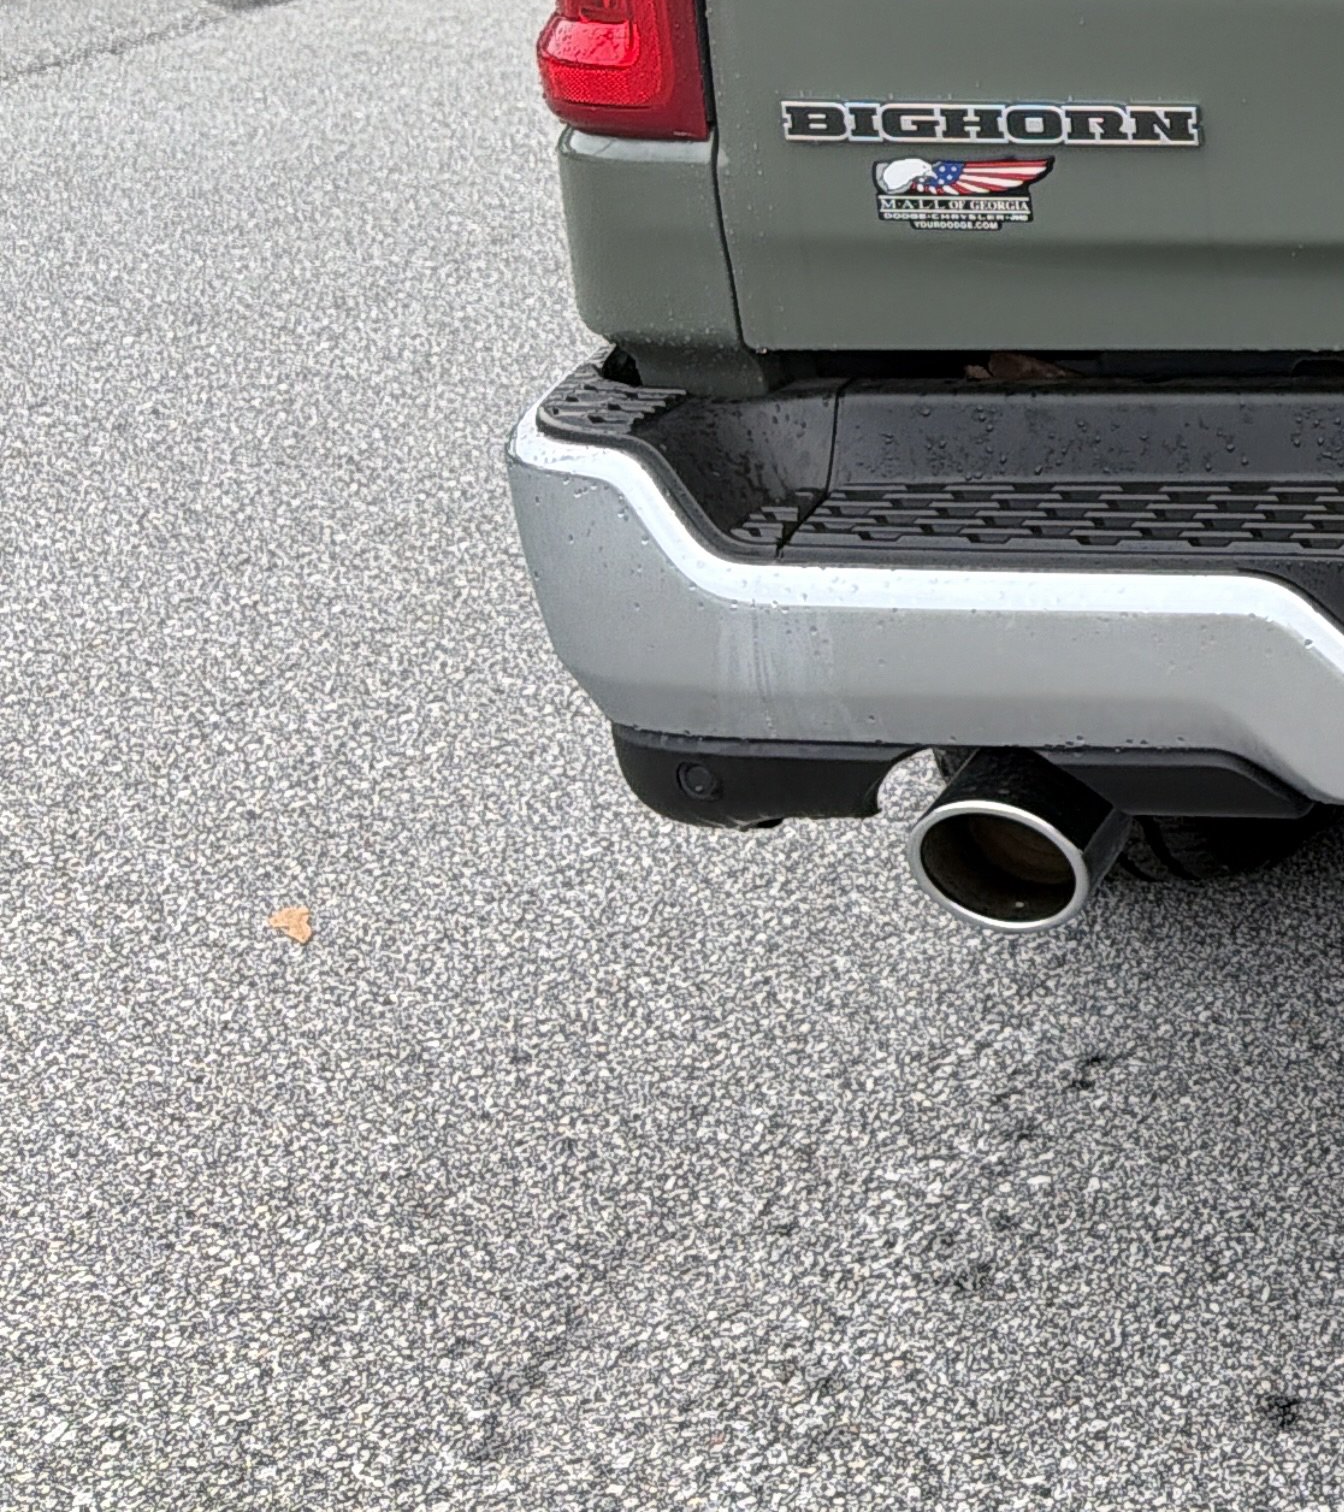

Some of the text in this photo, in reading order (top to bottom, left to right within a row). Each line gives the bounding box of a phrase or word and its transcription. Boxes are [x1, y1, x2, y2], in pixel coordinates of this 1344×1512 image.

[781, 100, 1201, 146] BIGHORN
[948, 200, 966, 210] OF
[970, 199, 1029, 211] GEORGIA
